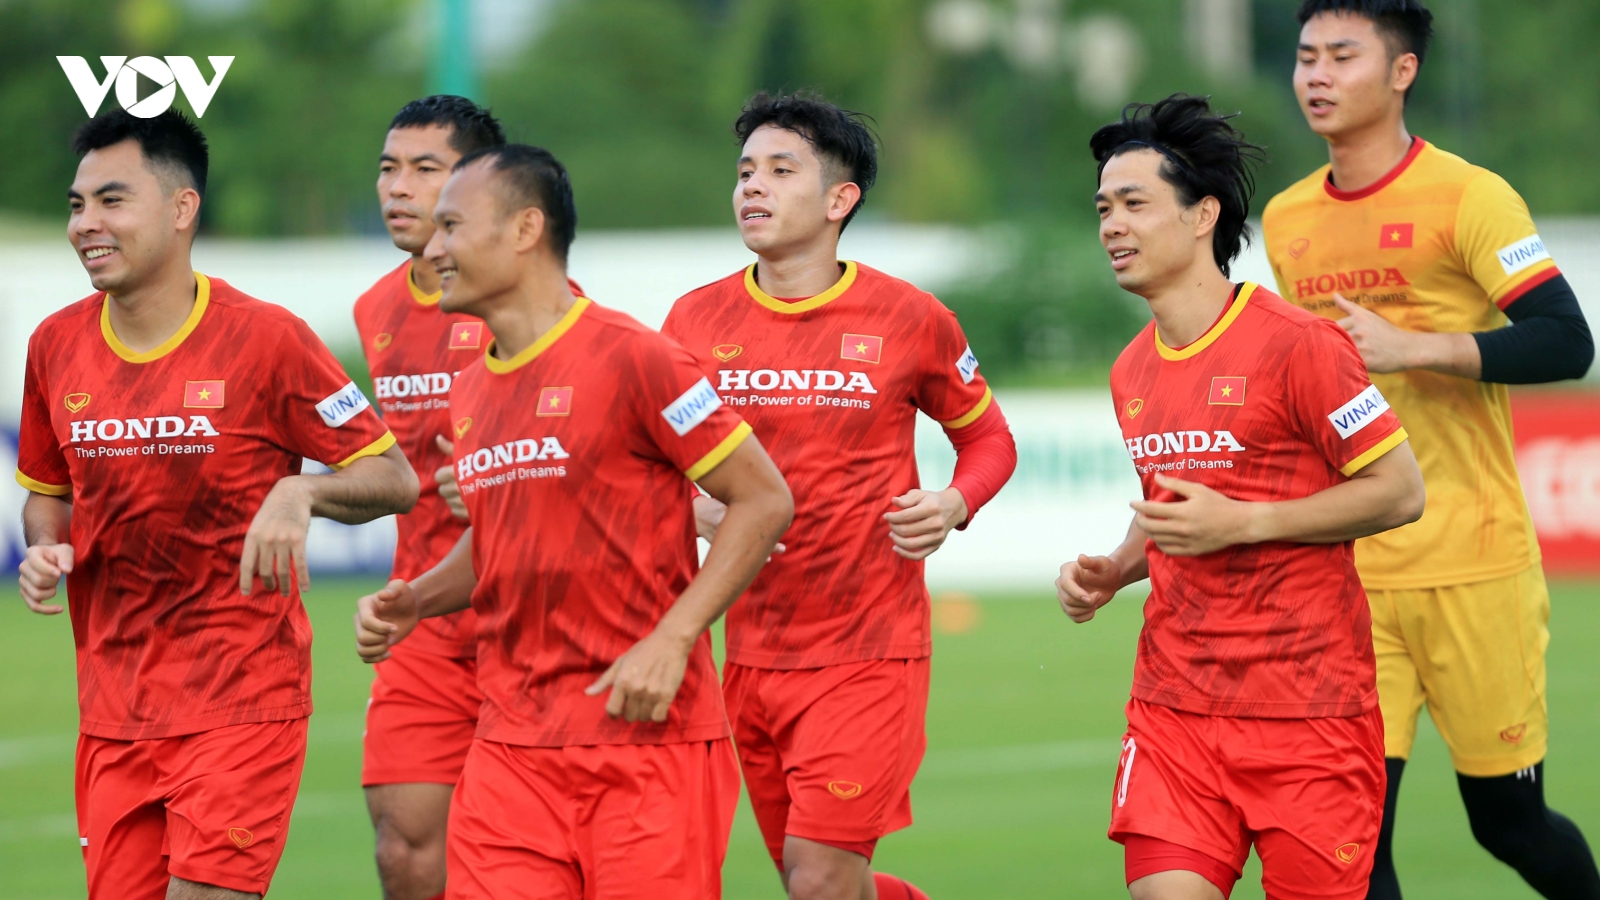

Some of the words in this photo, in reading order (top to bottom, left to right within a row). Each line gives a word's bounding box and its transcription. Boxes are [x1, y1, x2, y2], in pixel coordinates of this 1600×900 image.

[1295, 267, 1411, 299] HONDA
[1302, 301, 1317, 311] The
[1362, 292, 1407, 304] Dreams
[374, 371, 462, 399] HOND
[717, 369, 878, 394] HONDA
[395, 401, 422, 412] Power
[423, 398, 433, 410] of
[722, 395, 747, 406] The
[749, 395, 794, 406] Power
[796, 394, 813, 406] of
[815, 395, 871, 409] Dreams
[70, 415, 220, 443] HONDA
[74, 447, 96, 458] The
[98, 446, 139, 458] Power
[141, 444, 156, 455] of
[158, 443, 215, 455] Dreams
[1125, 430, 1246, 460] HONDA
[457, 436, 570, 481] HONDA
[1148, 462, 1176, 473] Power
[1176, 458, 1186, 470] of
[1188, 458, 1233, 469] Dreams
[460, 483, 475, 496] The
[475, 473, 507, 490] Power
[506, 468, 516, 482] of
[518, 465, 567, 480] Dreams
